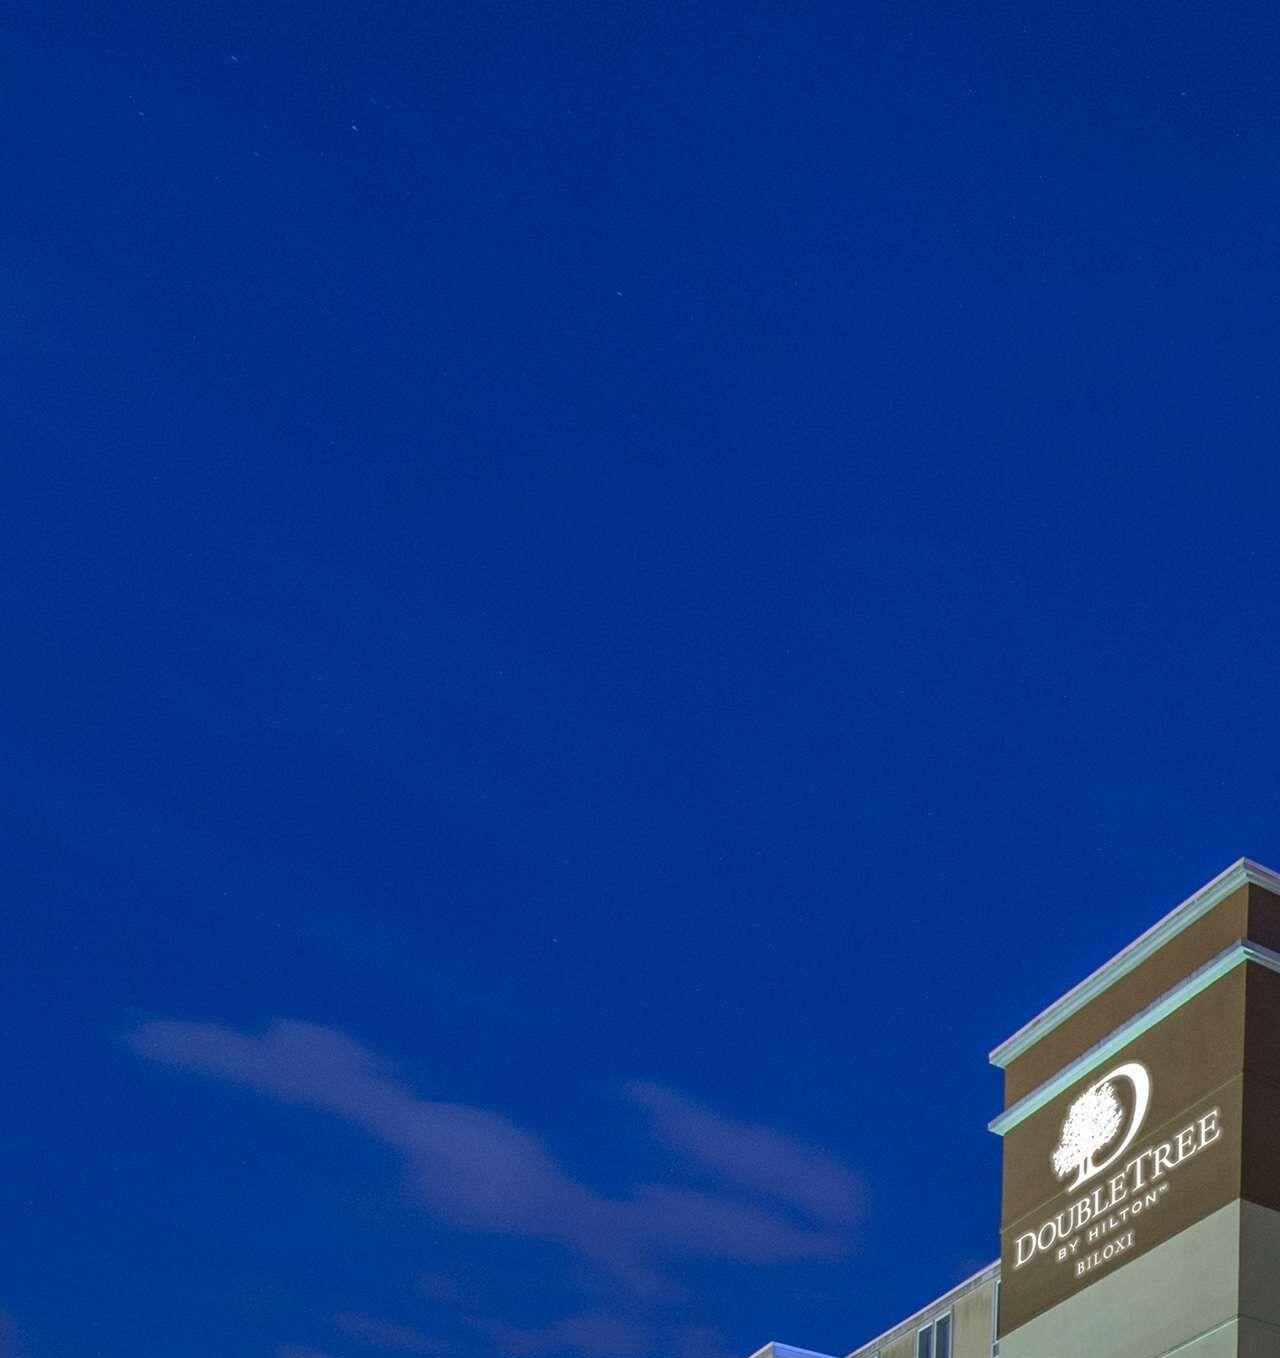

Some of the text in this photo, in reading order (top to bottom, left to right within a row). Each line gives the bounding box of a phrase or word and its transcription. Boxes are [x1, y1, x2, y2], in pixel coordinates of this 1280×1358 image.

[1014, 1110, 1221, 1268] DOUBLETREE
[1057, 1239, 1080, 1261] BY
[1077, 1231, 1135, 1275] BILOXI
